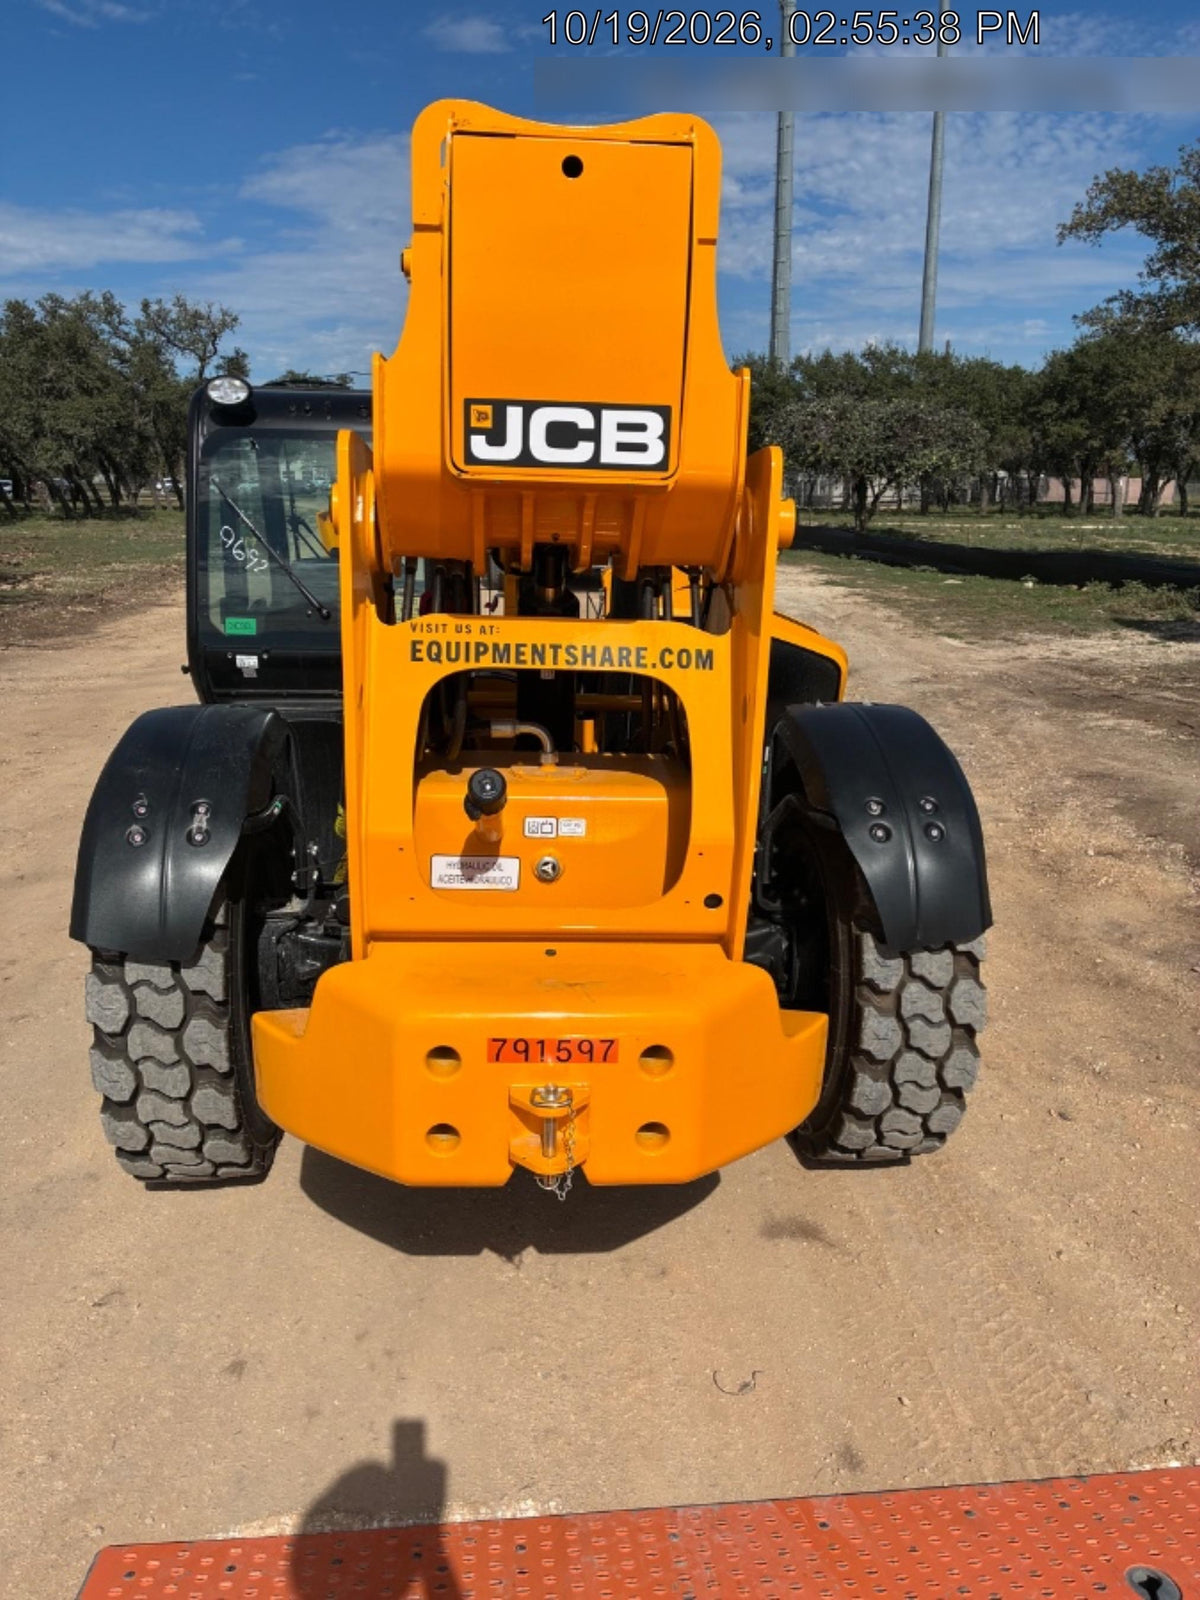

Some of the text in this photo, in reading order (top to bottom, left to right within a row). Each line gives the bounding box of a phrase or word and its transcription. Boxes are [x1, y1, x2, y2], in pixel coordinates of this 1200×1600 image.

[470, 405, 666, 466] JCB
[410, 622, 501, 636] VISIT US AT:
[410, 639, 714, 671] EQUIPMENTSHARE.COM
[491, 1037, 616, 1063] 791597
